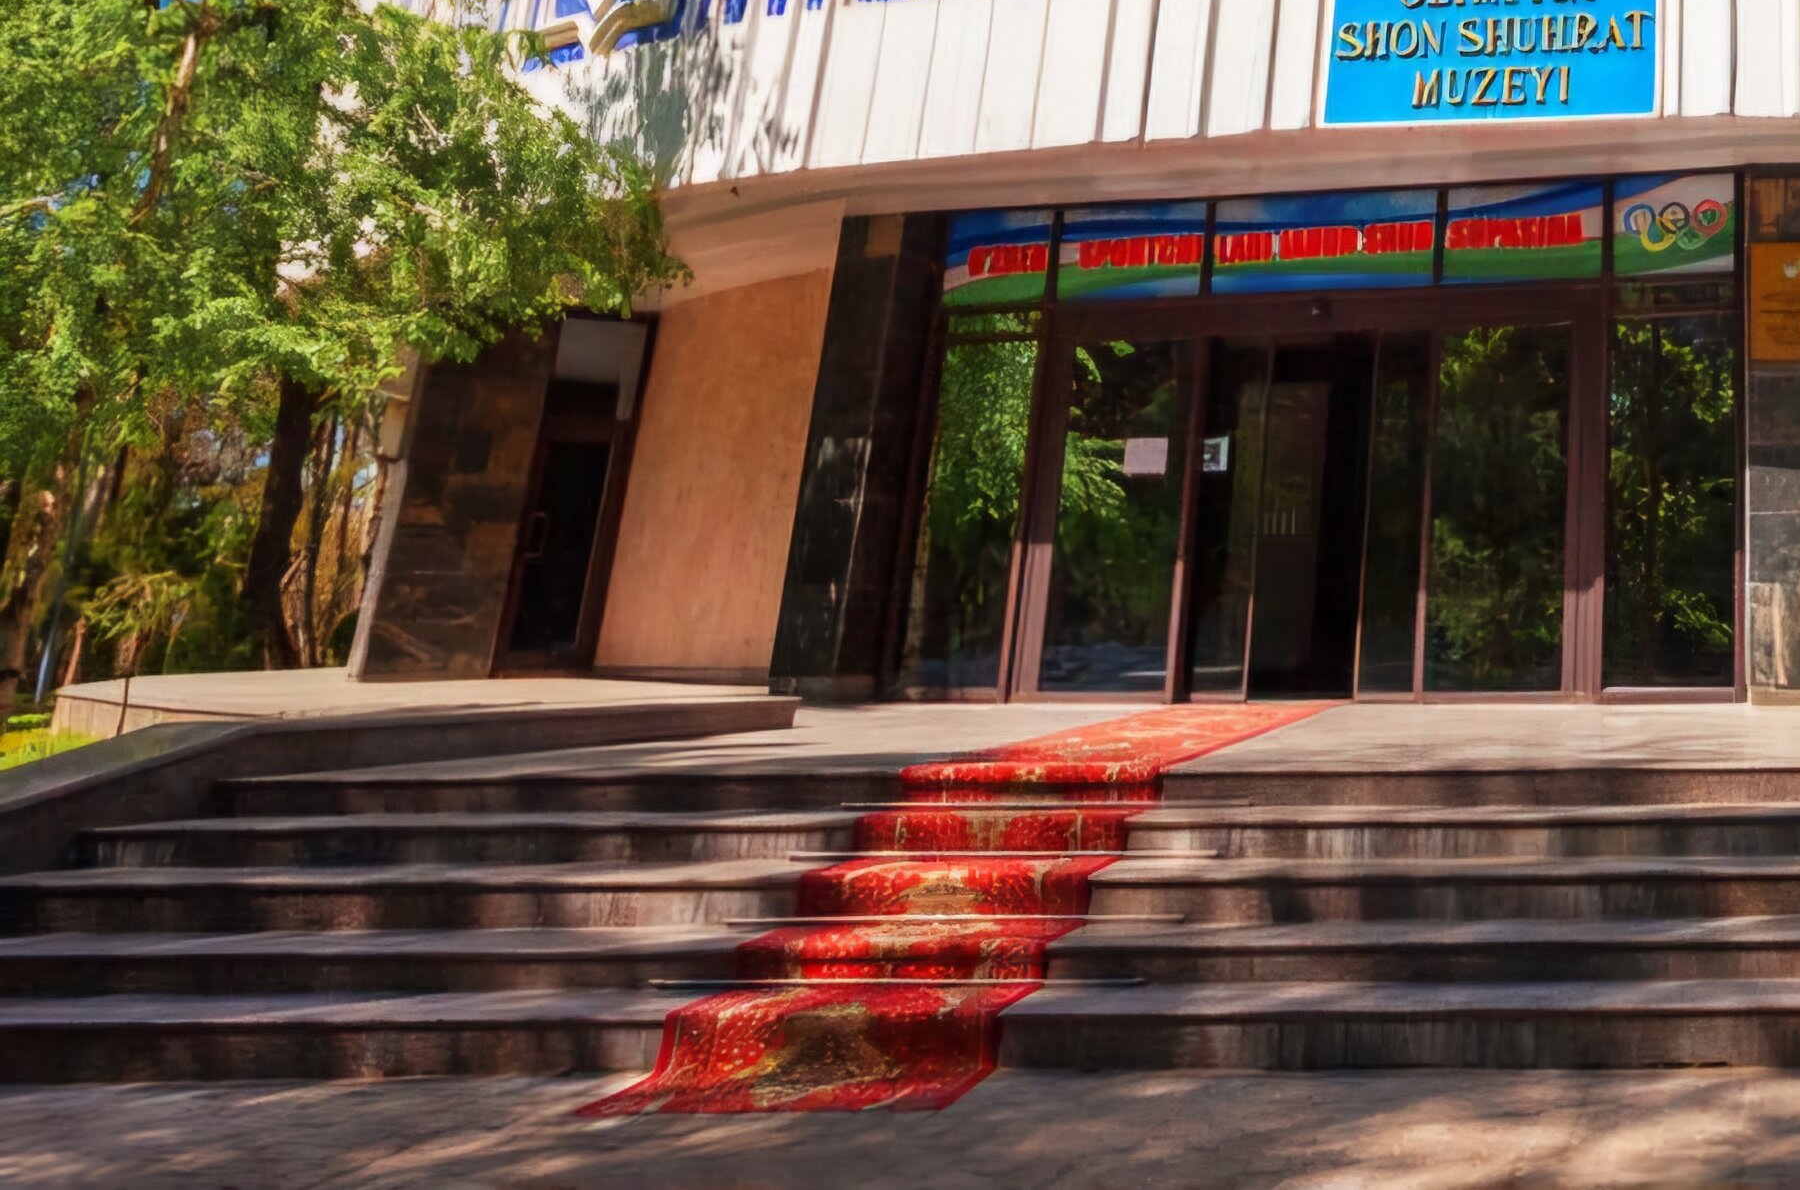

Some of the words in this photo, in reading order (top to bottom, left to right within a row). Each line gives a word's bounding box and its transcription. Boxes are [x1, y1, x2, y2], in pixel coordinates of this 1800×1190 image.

[1336, 18, 1446, 61] SHON
[1457, 11, 1656, 56] SHUHRAT
[1411, 65, 1570, 109] MUZEYI
